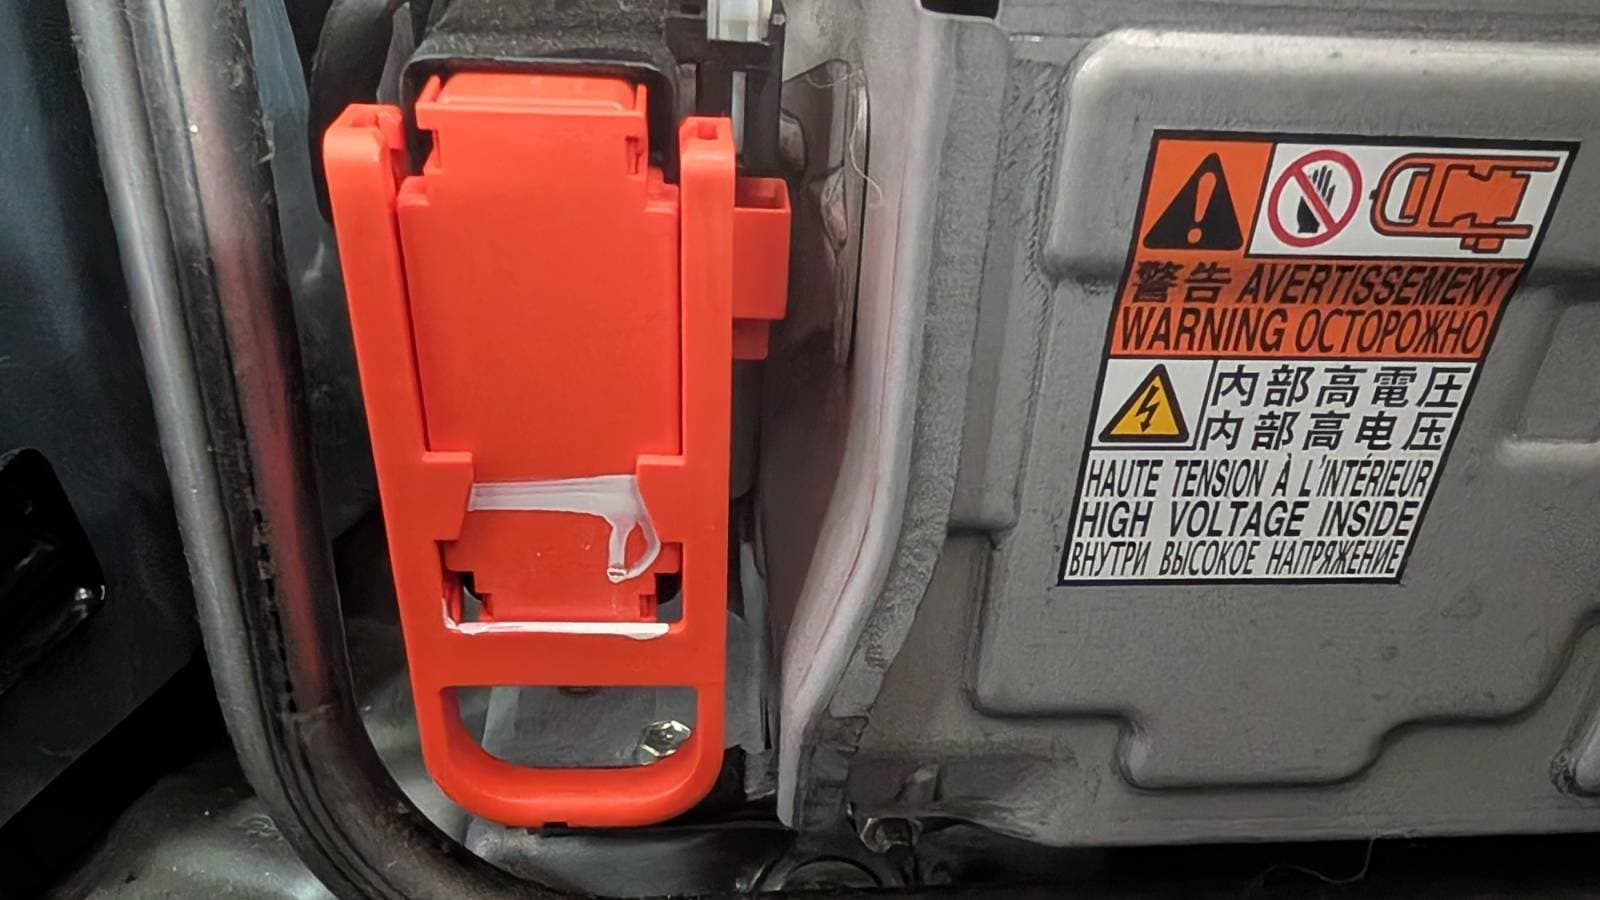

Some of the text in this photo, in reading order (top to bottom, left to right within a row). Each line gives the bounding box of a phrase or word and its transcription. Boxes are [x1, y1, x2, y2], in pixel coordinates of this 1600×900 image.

[1131, 260, 1516, 306] 警告 AVERTISSEMENT
[1120, 307, 1488, 355] WARNING ОСТОРОЖНО
[1211, 364, 1471, 408] 内部高電圧
[1199, 410, 1453, 451] 内部高电压
[1085, 452, 1433, 498] HAUTE TENSION À L'INTÉRIEUR
[1077, 501, 1419, 538] HIGH VOLTAGE INSIDE
[1069, 540, 1405, 577] ВНУТРИ ВЫСОКОЕ НАПРЯЖЕНИЕ
